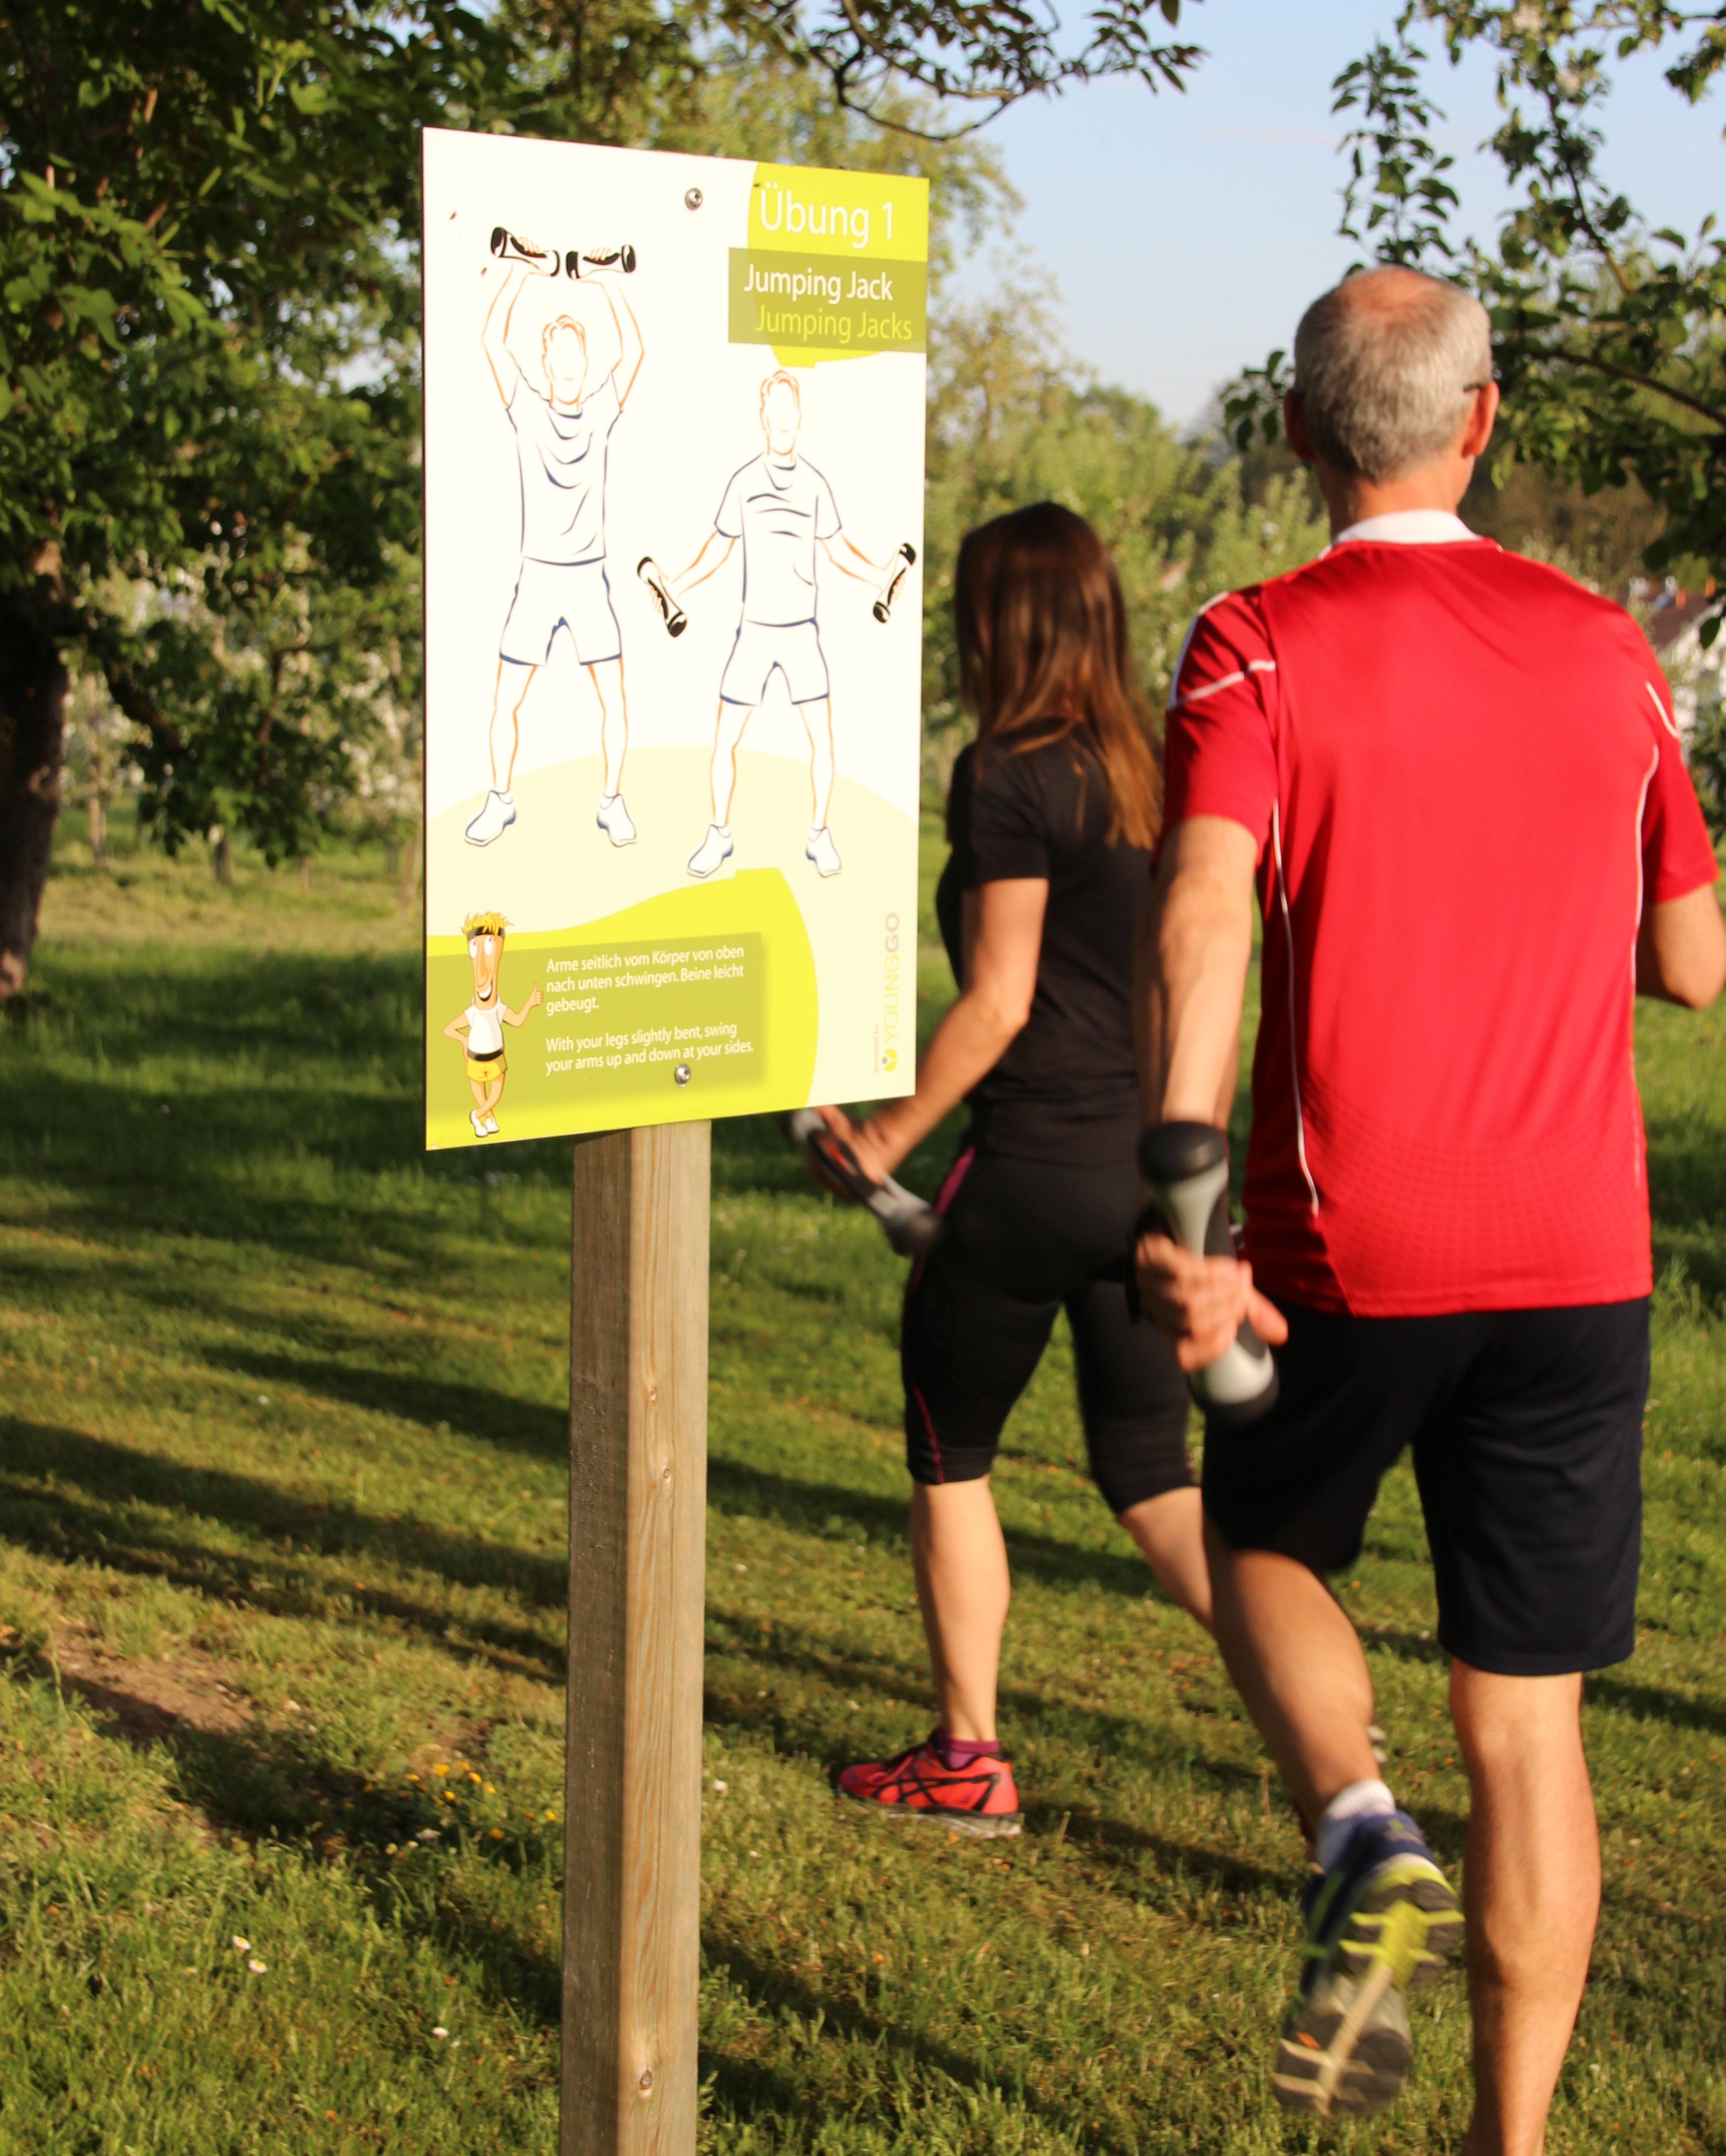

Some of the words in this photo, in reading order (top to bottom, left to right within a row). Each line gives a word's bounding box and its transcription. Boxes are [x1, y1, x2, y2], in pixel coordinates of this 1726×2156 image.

[760, 182, 869, 248] Übung
[883, 202, 892, 239] 1
[744, 263, 841, 305] Jumping
[847, 271, 893, 301] Jack
[756, 305, 851, 343] Jumping
[858, 311, 911, 340] Jacks
[547, 958, 578, 973] Arme
[581, 953, 621, 970] seitlich
[624, 954, 649, 966] vom
[652, 950, 690, 968] Körper
[693, 949, 714, 960] von
[716, 945, 744, 960] oben
[547, 977, 575, 992] nach
[578, 975, 612, 990] unten
[615, 971, 679, 989] schwingen.
[681, 967, 711, 982] Beine
[714, 964, 744, 978] leicht
[546, 996, 599, 1017] gebeugt.
[546, 1037, 573, 1052] With
[576, 1036, 603, 1052] your
[606, 1032, 629, 1049] legs
[631, 1028, 672, 1045] slightly
[675, 1025, 702, 1040] bent,
[705, 1022, 737, 1038] swing
[546, 1058, 572, 1075] your
[575, 1055, 603, 1069] arms
[606, 1053, 622, 1068] up
[624, 1049, 646, 1064] and
[649, 1047, 681, 1062] down
[684, 1046, 694, 1058] at
[697, 1044, 722, 1060] your
[724, 1039, 754, 1054] sides.
